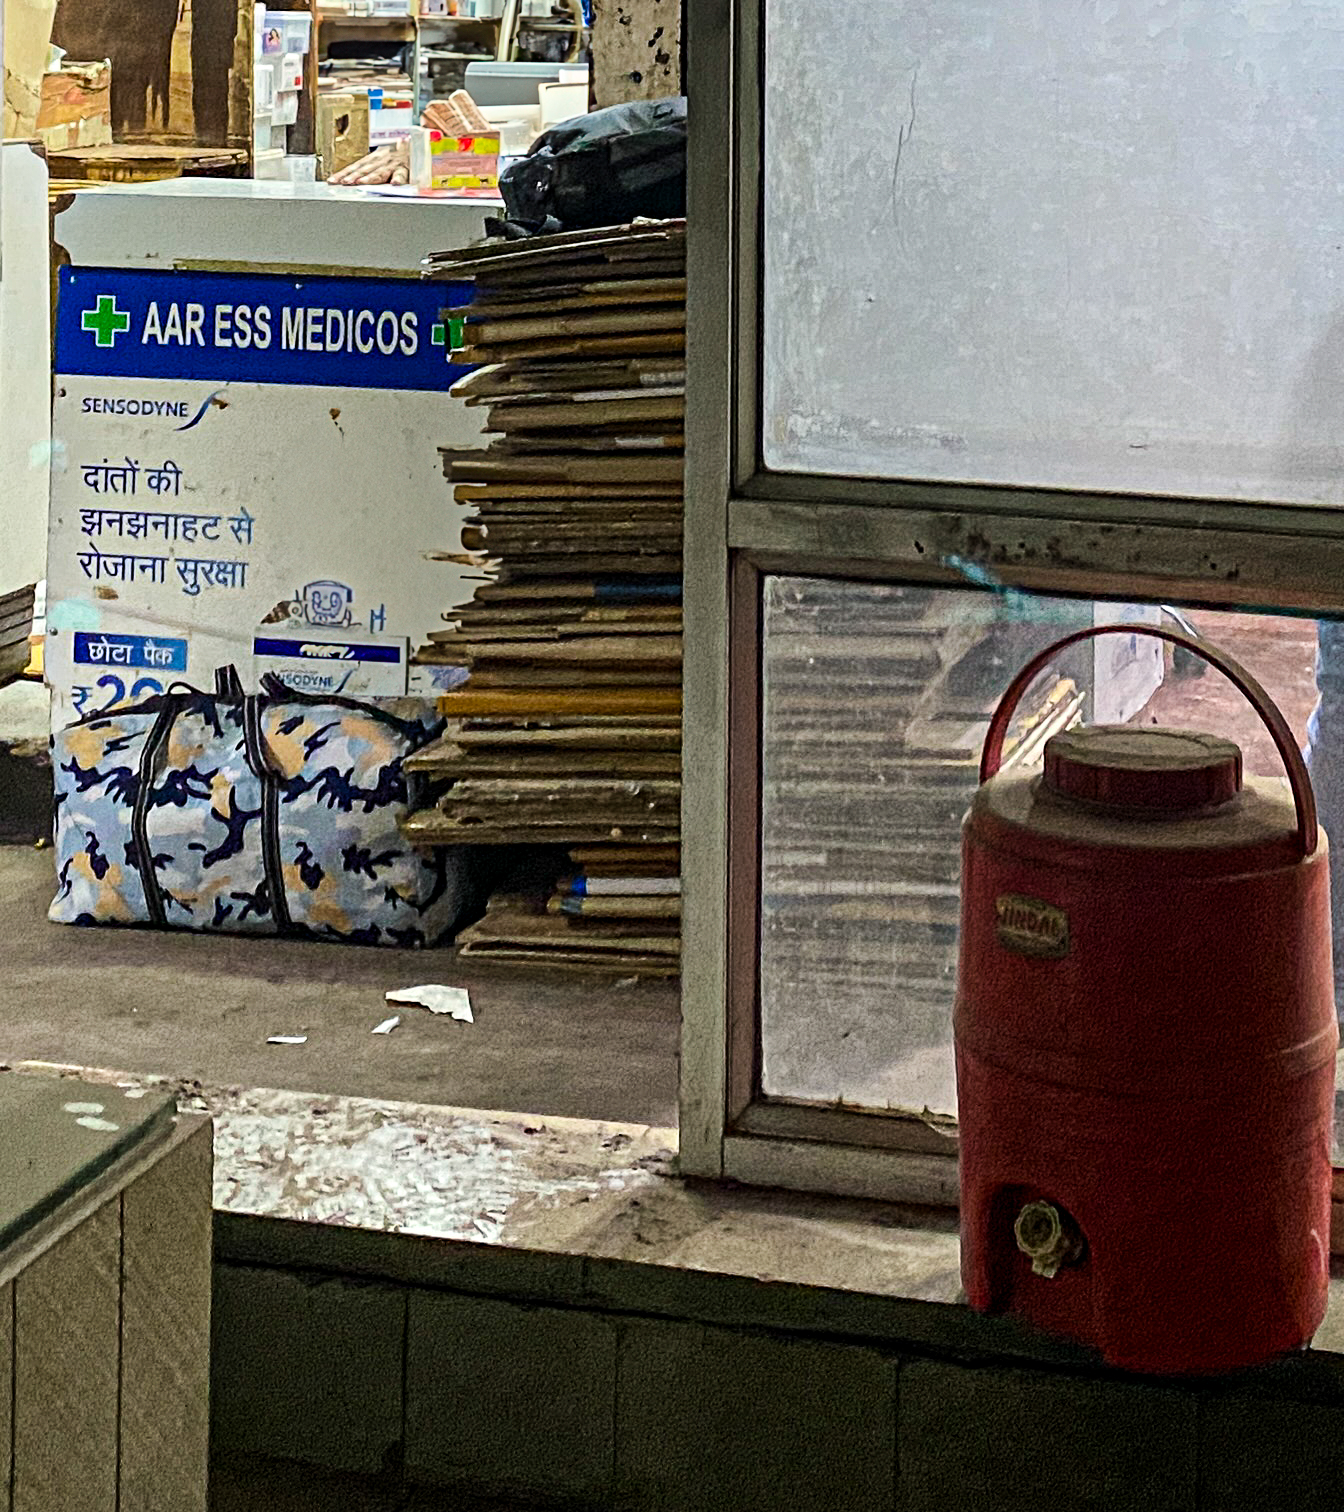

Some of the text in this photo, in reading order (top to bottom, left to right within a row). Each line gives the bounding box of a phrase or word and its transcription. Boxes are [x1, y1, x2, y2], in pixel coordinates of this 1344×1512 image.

[141, 302, 419, 356] AAR ESS MEDICOS
[81, 396, 189, 419] SENSODYNE
[80, 456, 183, 496] दांतों की
[79, 506, 255, 545] झनझनाहट से
[76, 542, 249, 596] रोजाना सुरक्षा
[87, 635, 175, 665] छोटा पैक
